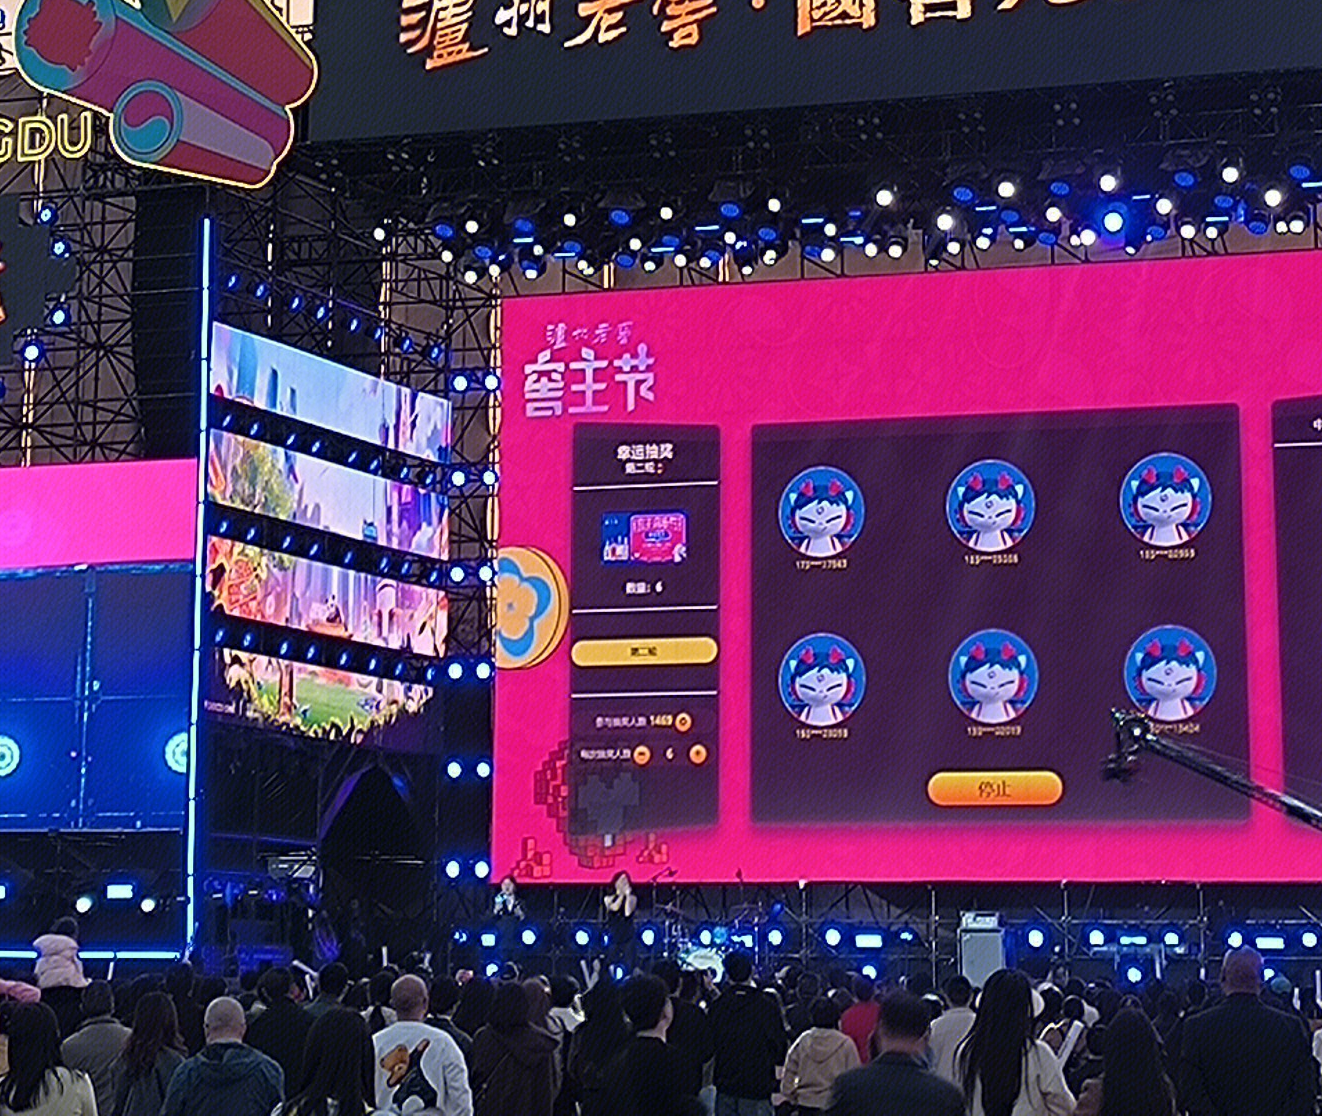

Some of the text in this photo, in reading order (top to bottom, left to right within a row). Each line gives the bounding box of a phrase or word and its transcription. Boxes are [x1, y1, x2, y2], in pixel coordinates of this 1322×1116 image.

[523, 342, 656, 418] 窖主节
[978, 780, 1012, 798] 停止
